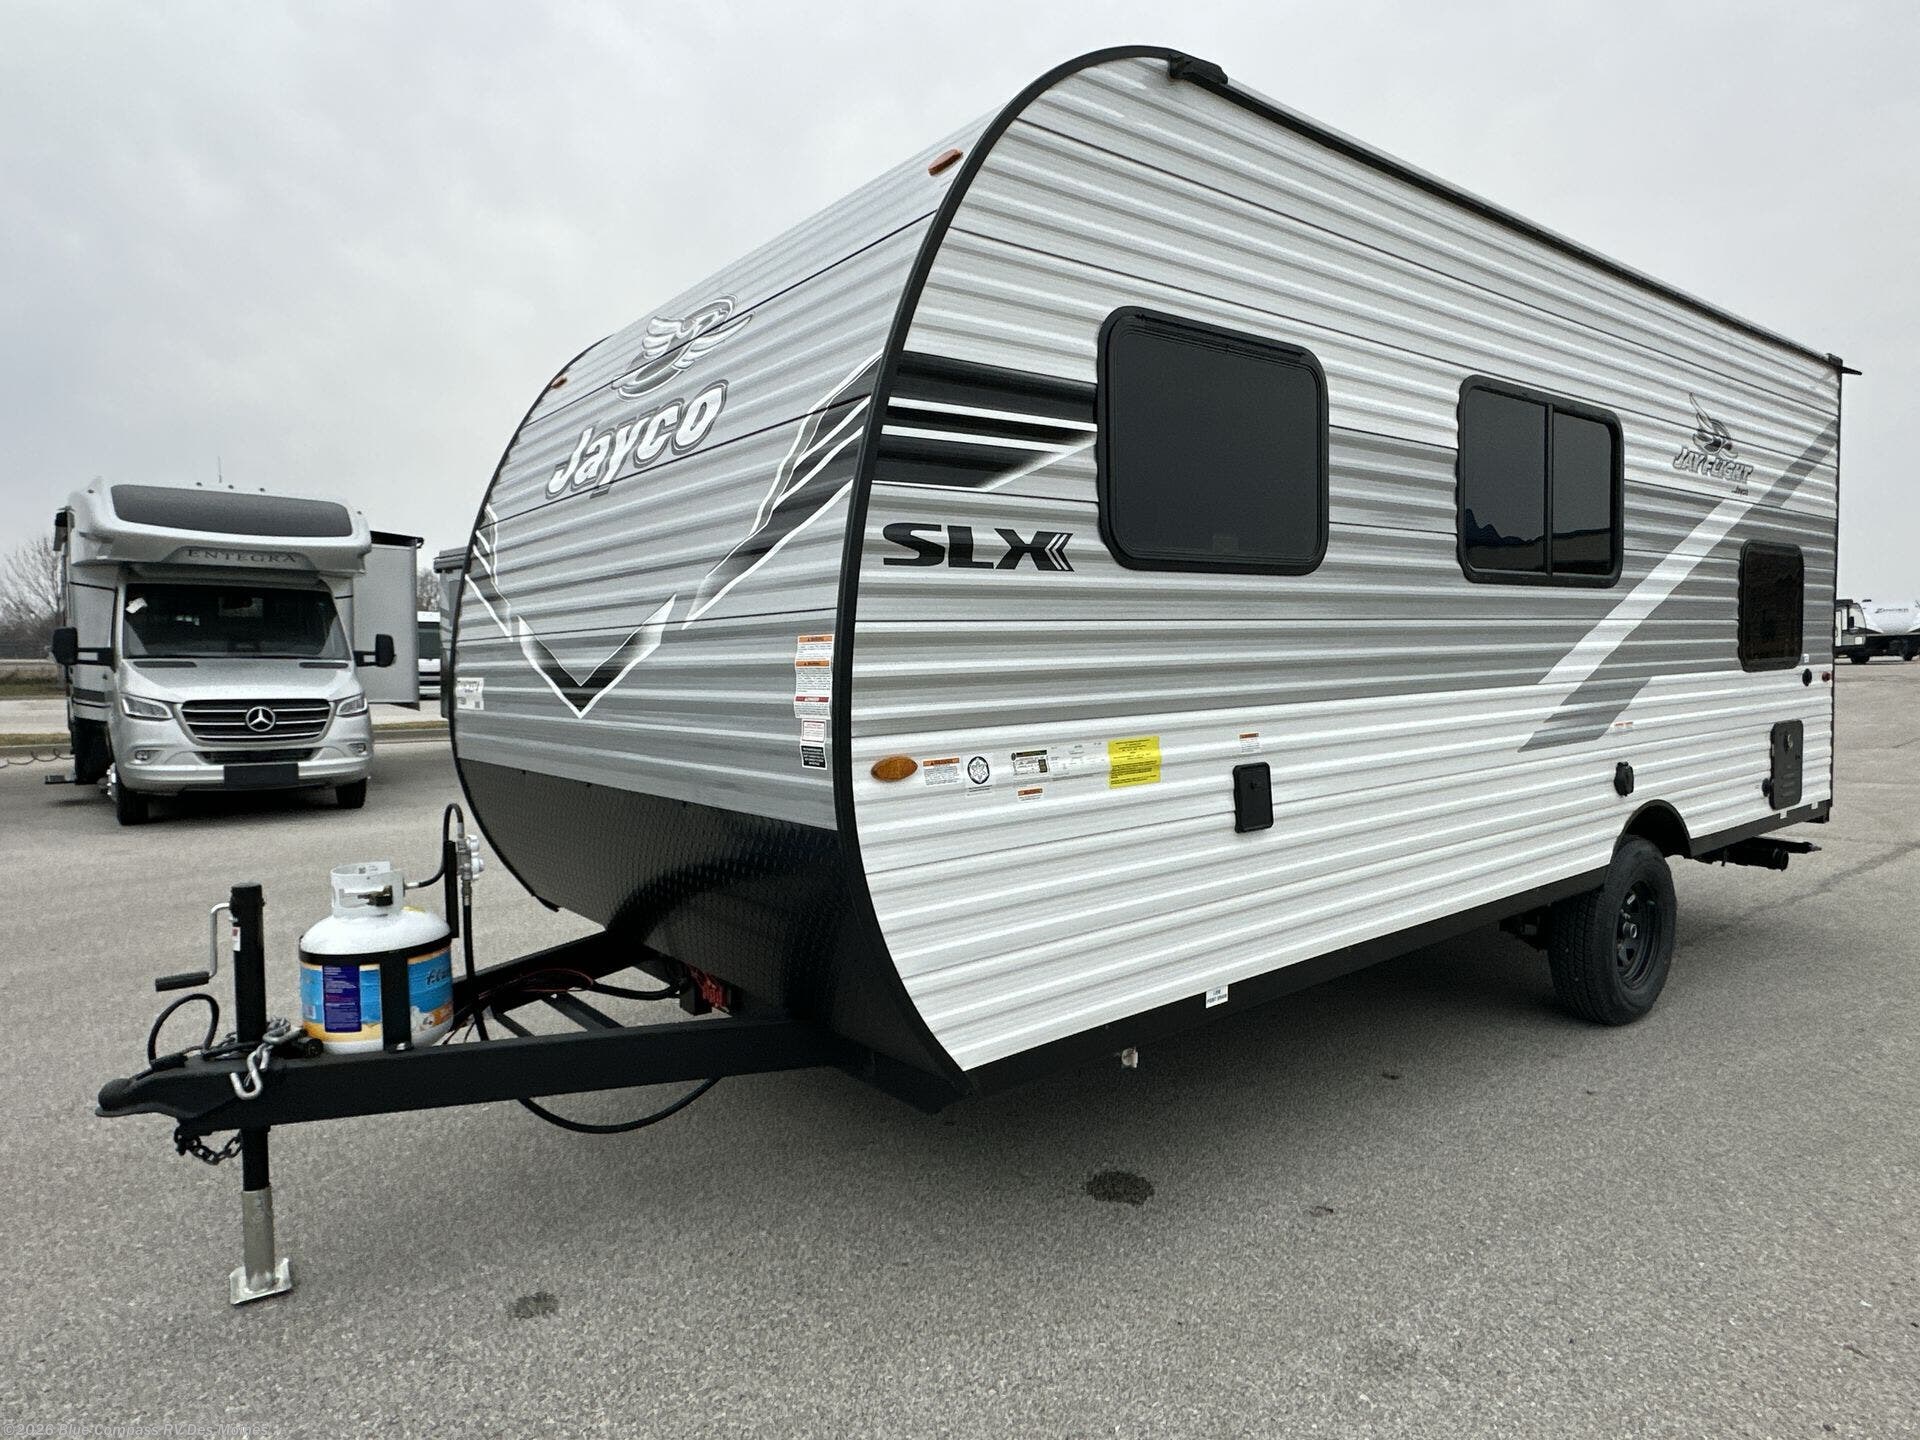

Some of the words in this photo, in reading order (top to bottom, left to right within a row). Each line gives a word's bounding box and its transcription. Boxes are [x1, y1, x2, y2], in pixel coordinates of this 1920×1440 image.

[546, 379, 729, 499] Jayco
[1673, 446, 1707, 473] JAY
[1701, 454, 1754, 484] FLIGHT
[188, 549, 297, 563] ENTEGRA
[883, 522, 1075, 572] SLX
